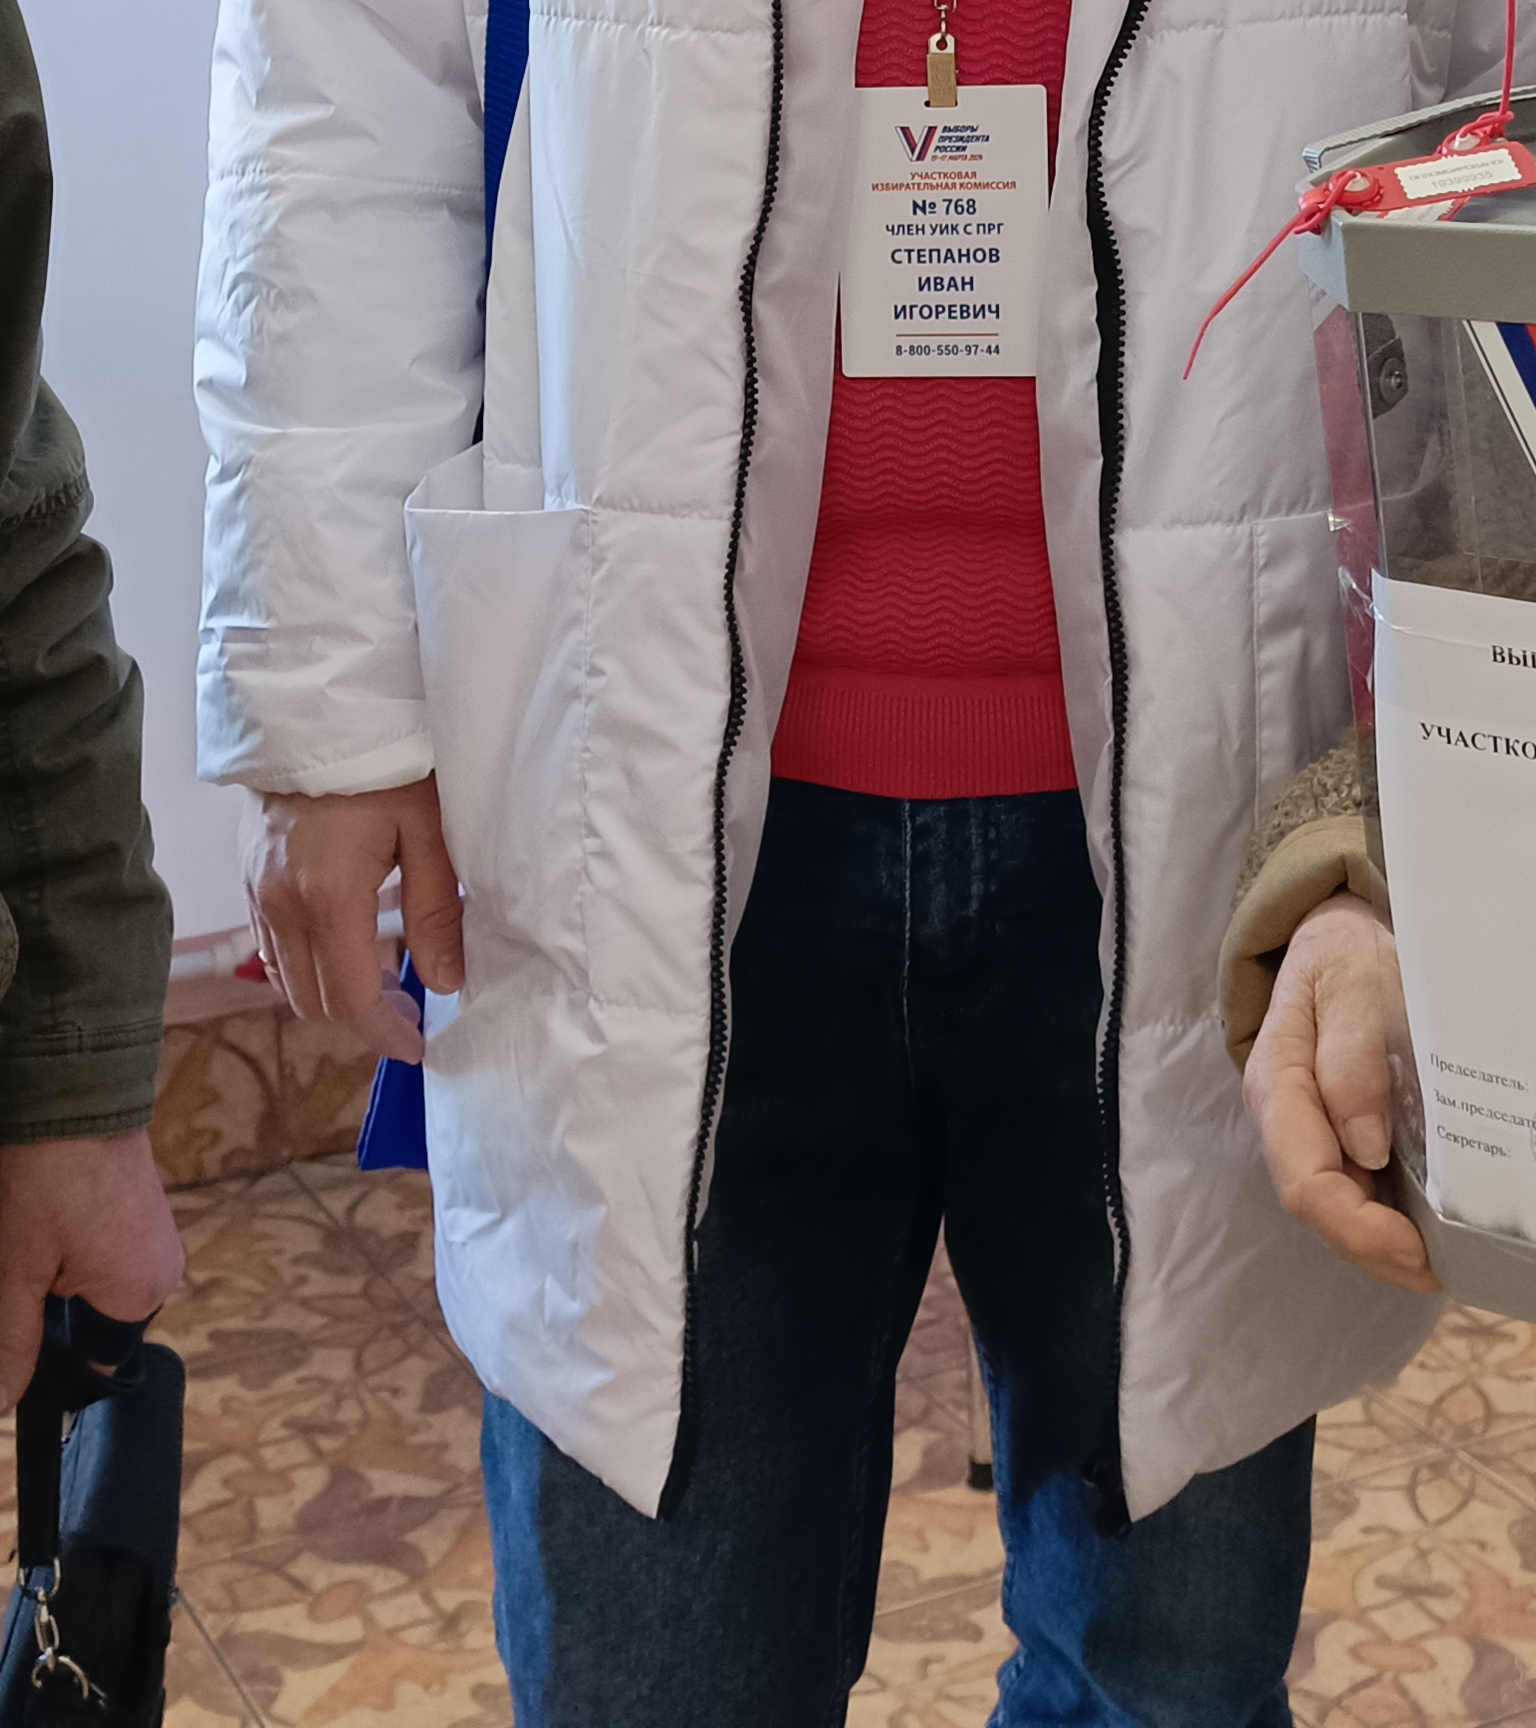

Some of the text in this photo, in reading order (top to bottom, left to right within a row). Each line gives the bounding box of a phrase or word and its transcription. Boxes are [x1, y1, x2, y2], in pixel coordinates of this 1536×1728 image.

[941, 124, 980, 133] ВЫБОРЫ
[937, 134, 990, 144] ПРЕЗИДЕНТА
[934, 144, 968, 153] РОССИИ
[910, 171, 977, 181] УЧАСТКОВАЯ
[871, 180, 1017, 192] ИЗБИРАТЕЛЬНАЯ КОМИССИЯ
[911, 197, 977, 216] № 768
[885, 223, 1005, 236] ЧЛЕН УИК С ПРГ
[889, 247, 1001, 265] СТЕПАНОВ
[917, 275, 975, 292] ИВАН
[893, 304, 1001, 320] ИГОРЕВИЧ
[895, 344, 1001, 357] 8-800-550-97-44
[1430, 1053, 1529, 1092] Председатель:
[1436, 1125, 1512, 1159] Секретарь:
